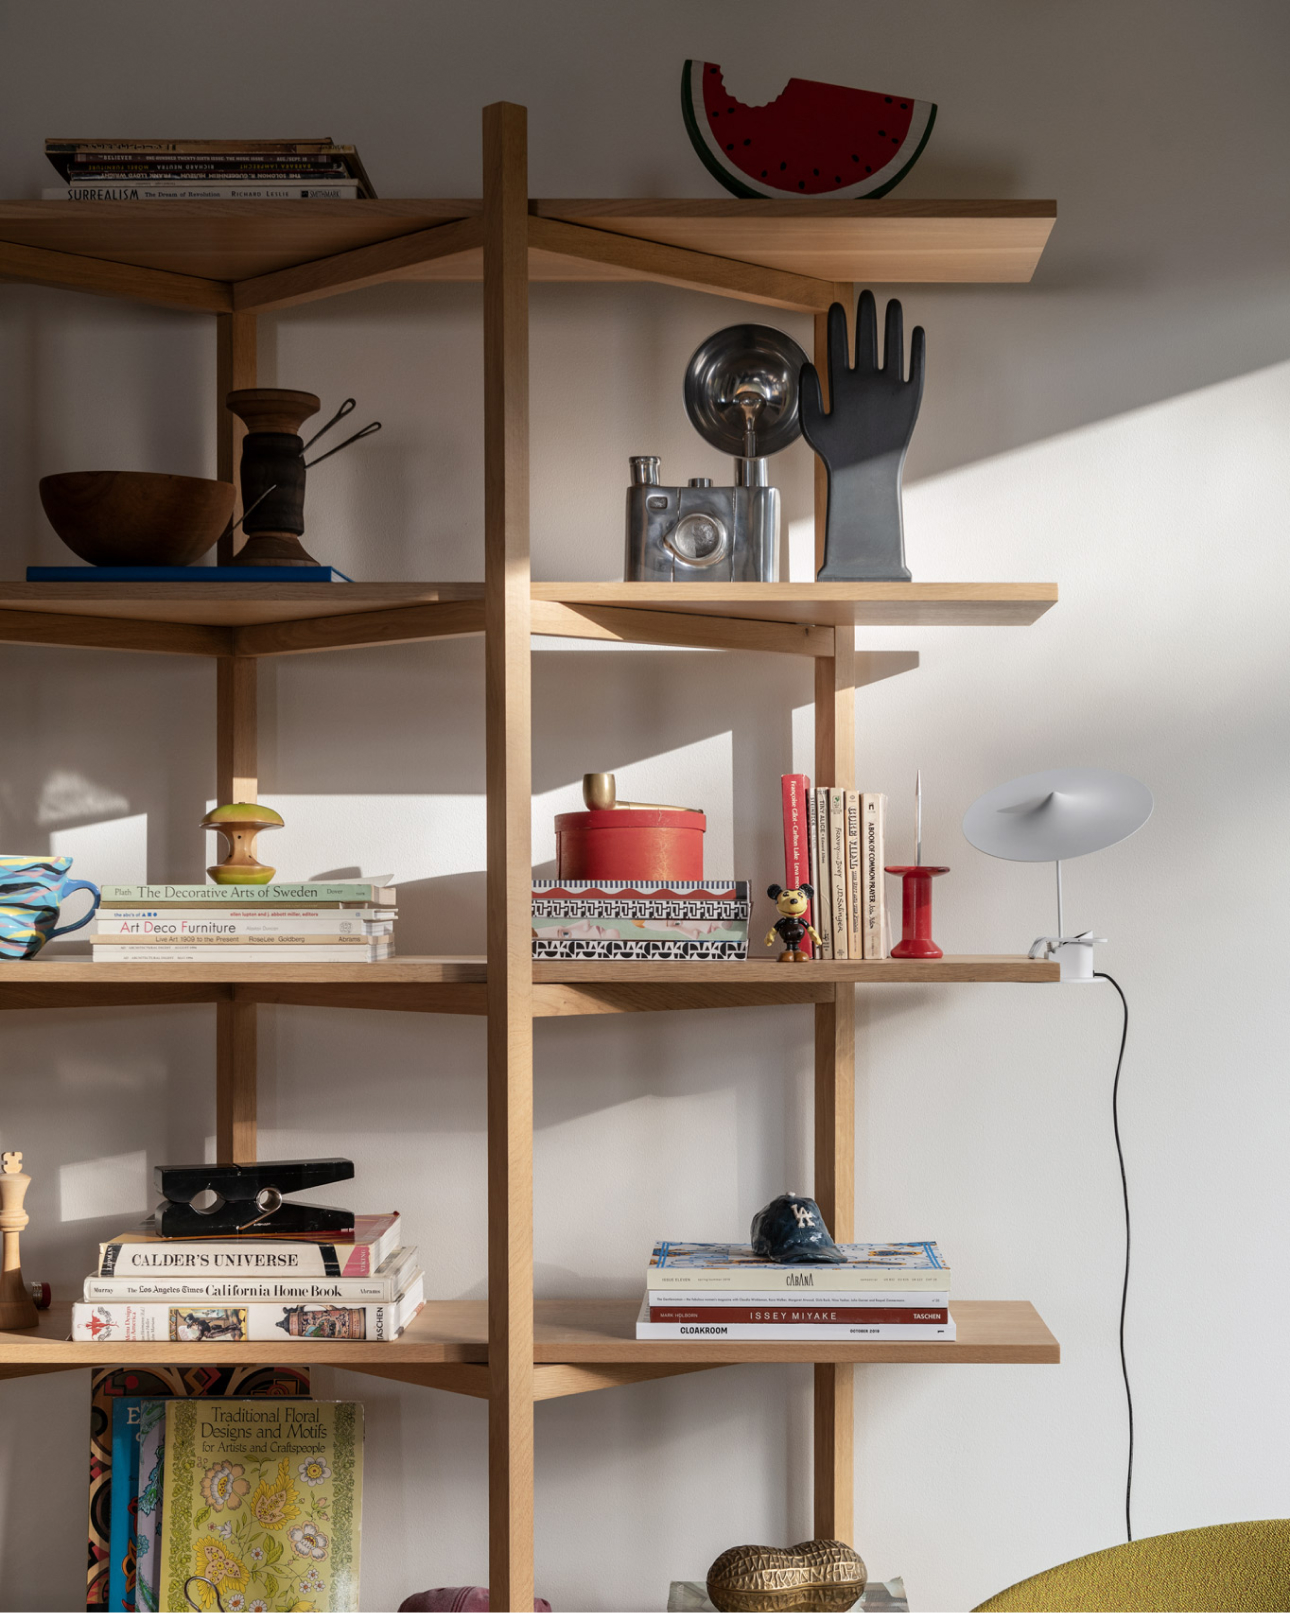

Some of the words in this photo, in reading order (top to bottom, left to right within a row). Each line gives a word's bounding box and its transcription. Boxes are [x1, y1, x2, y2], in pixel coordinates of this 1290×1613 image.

[67, 188, 139, 200] SURREALISM
[848, 806, 857, 836] GORE
[869, 845, 876, 853] OF
[115, 888, 132, 896] Plath
[137, 886, 160, 898] The
[165, 886, 228, 898] Decorative
[230, 886, 254, 898] Arts
[258, 886, 270, 898] of
[273, 886, 318, 898] Sweden
[120, 921, 140, 933] Art
[144, 921, 177, 933] Deco
[182, 921, 236, 933] Furniture
[131, 1254, 210, 1267] CALDER'S
[213, 1254, 299, 1267] UNIVERSE
[786, 1273, 814, 1286] CABANA
[139, 1285, 152, 1293] Los
[152, 1285, 180, 1295] Angeles
[181, 1286, 204, 1294] Times
[205, 1284, 270, 1297] California
[274, 1284, 309, 1297] Home
[311, 1285, 342, 1297] Book
[750, 1312, 787, 1320] ISSEY
[792, 1312, 837, 1320] MIYAKE
[376, 1307, 384, 1341] TASCHEN
[680, 1326, 728, 1335] CLOAKROOM
[211, 1406, 280, 1423] Traditional
[285, 1406, 320, 1423] Floral
[201, 1424, 252, 1442] Designs
[256, 1424, 282, 1439] and
[286, 1424, 328, 1439] Motifs
[202, 1442, 215, 1453] for
[218, 1442, 246, 1453] Artists
[249, 1442, 268, 1453] and
[270, 1442, 327, 1455] Craftspeople
